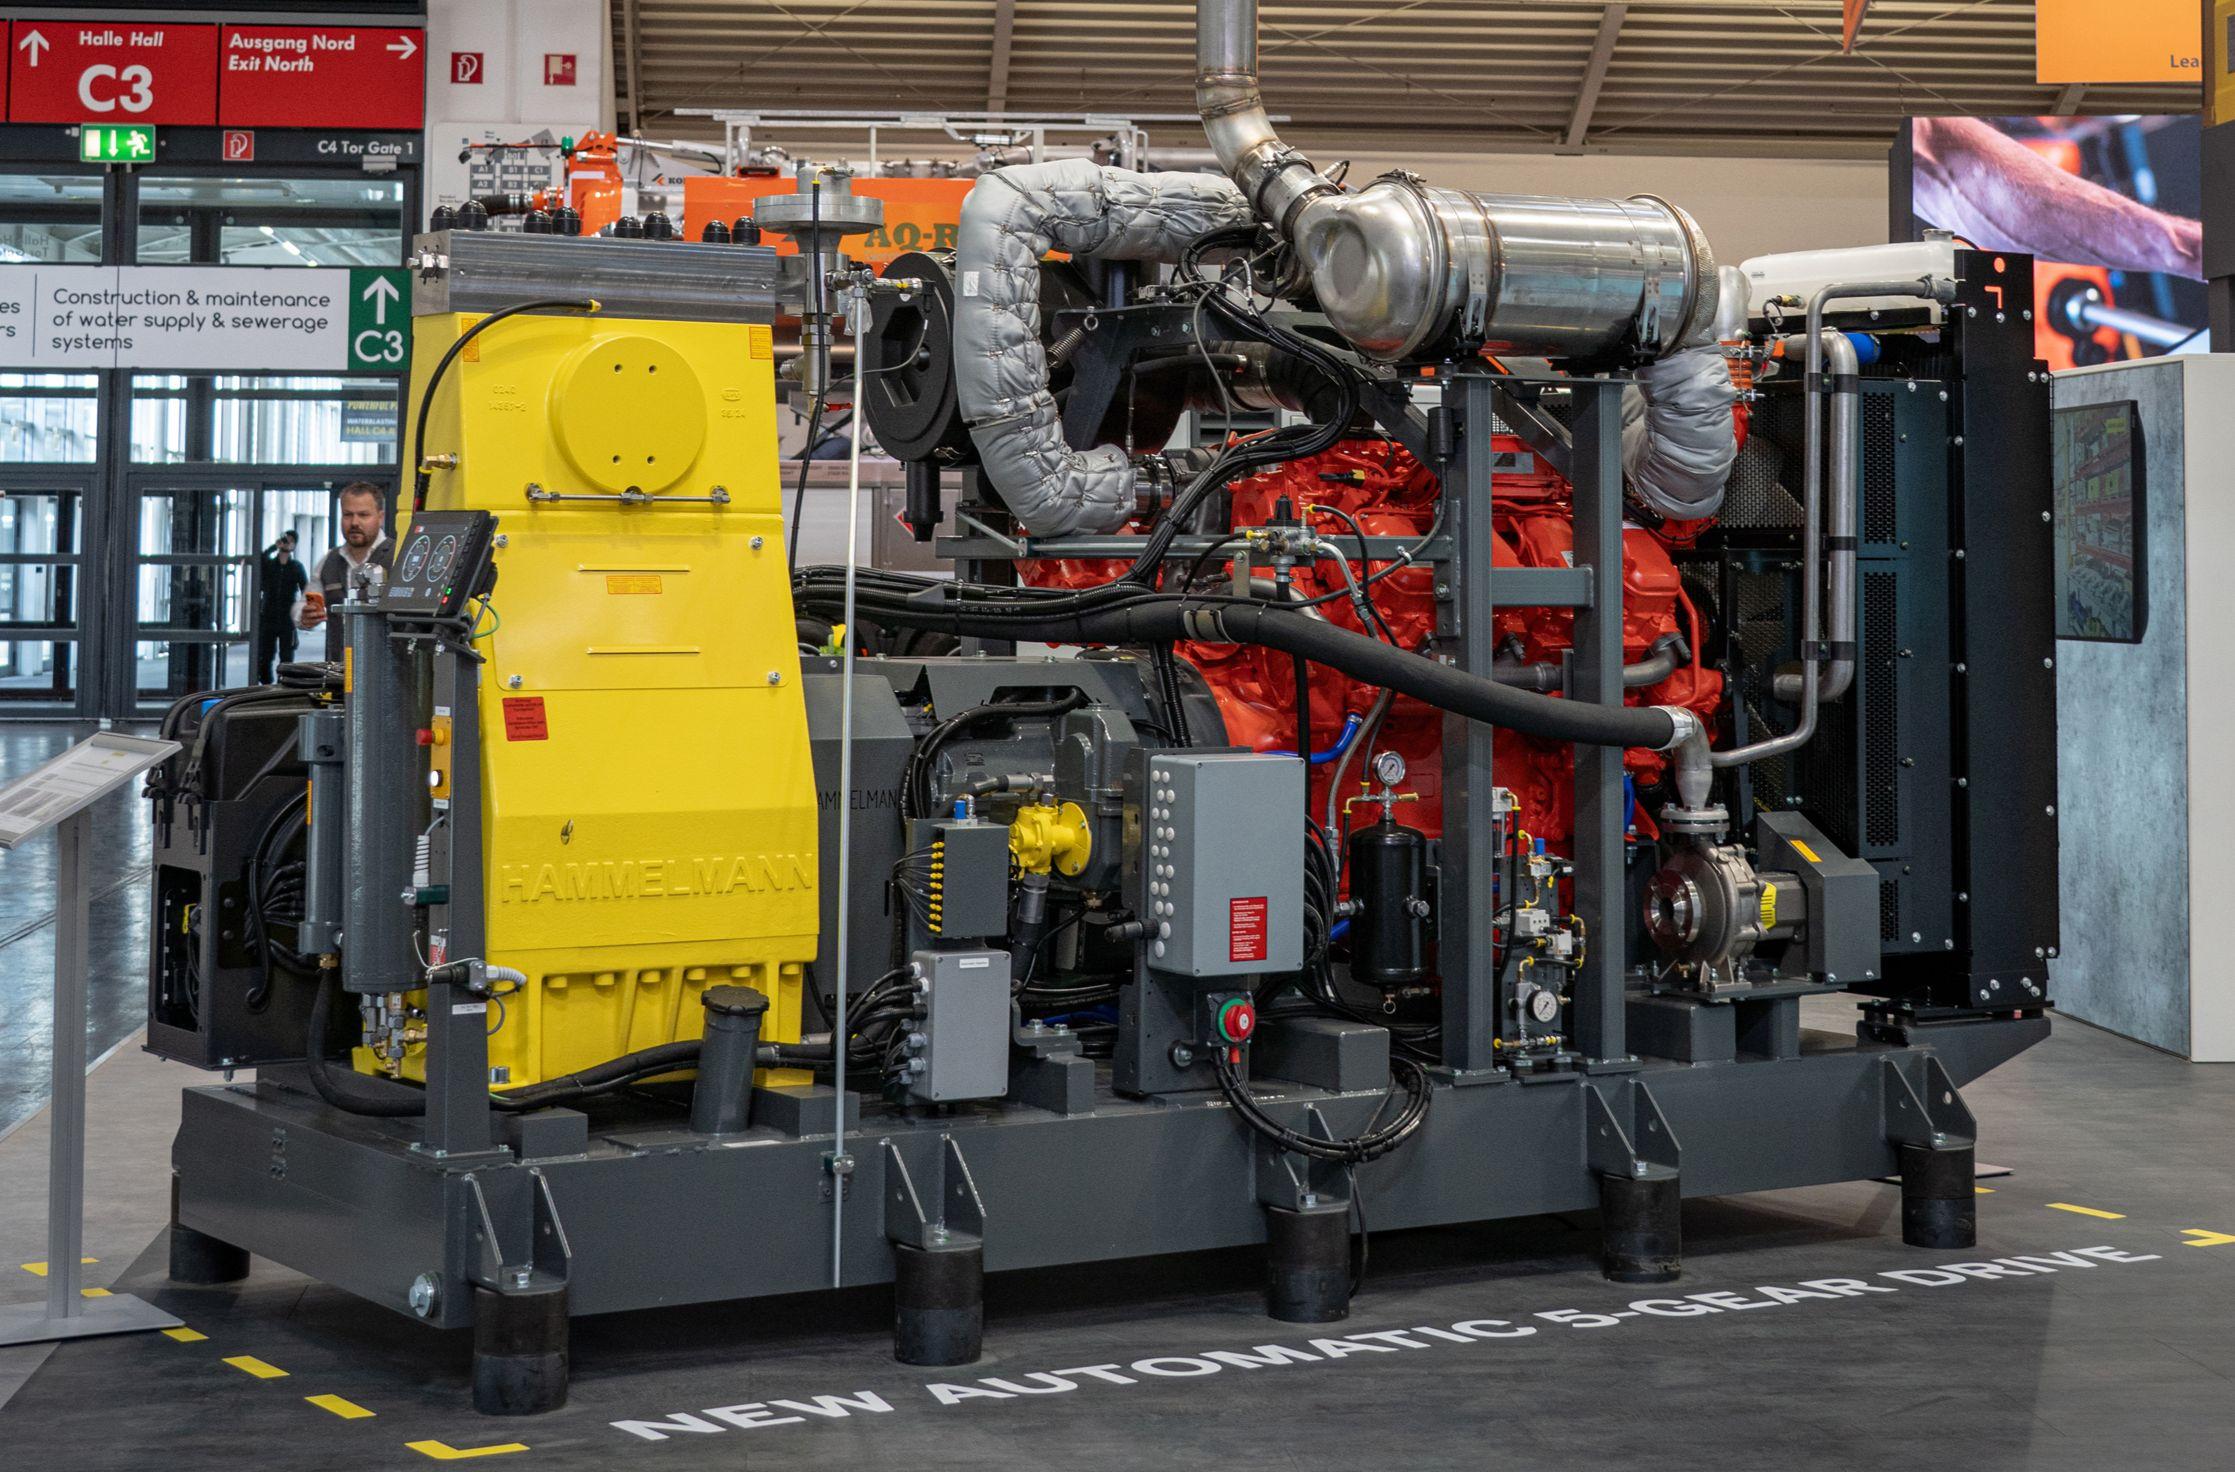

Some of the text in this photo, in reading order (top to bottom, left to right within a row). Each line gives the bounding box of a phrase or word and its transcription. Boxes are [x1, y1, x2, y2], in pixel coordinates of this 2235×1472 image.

[79, 30, 164, 47] Halle Hall
[229, 33, 355, 54] Ausgang Nord
[228, 54, 314, 72] Exit North
[2170, 54, 2199, 68] Lea
[78, 64, 153, 113] C3
[318, 140, 413, 155] C4 Tor Gate 1
[53, 288, 331, 307] Construction & maintenance
[52, 310, 329, 334] of water supply & sewerage
[52, 333, 133, 353] systems
[354, 329, 404, 363] C3
[817, 789, 897, 810] AMELMAN
[502, 853, 813, 903] HAMMELMANN
[608, 1245, 2163, 1442] NEW AUTOMATIC 5-GEAR DRIVE
